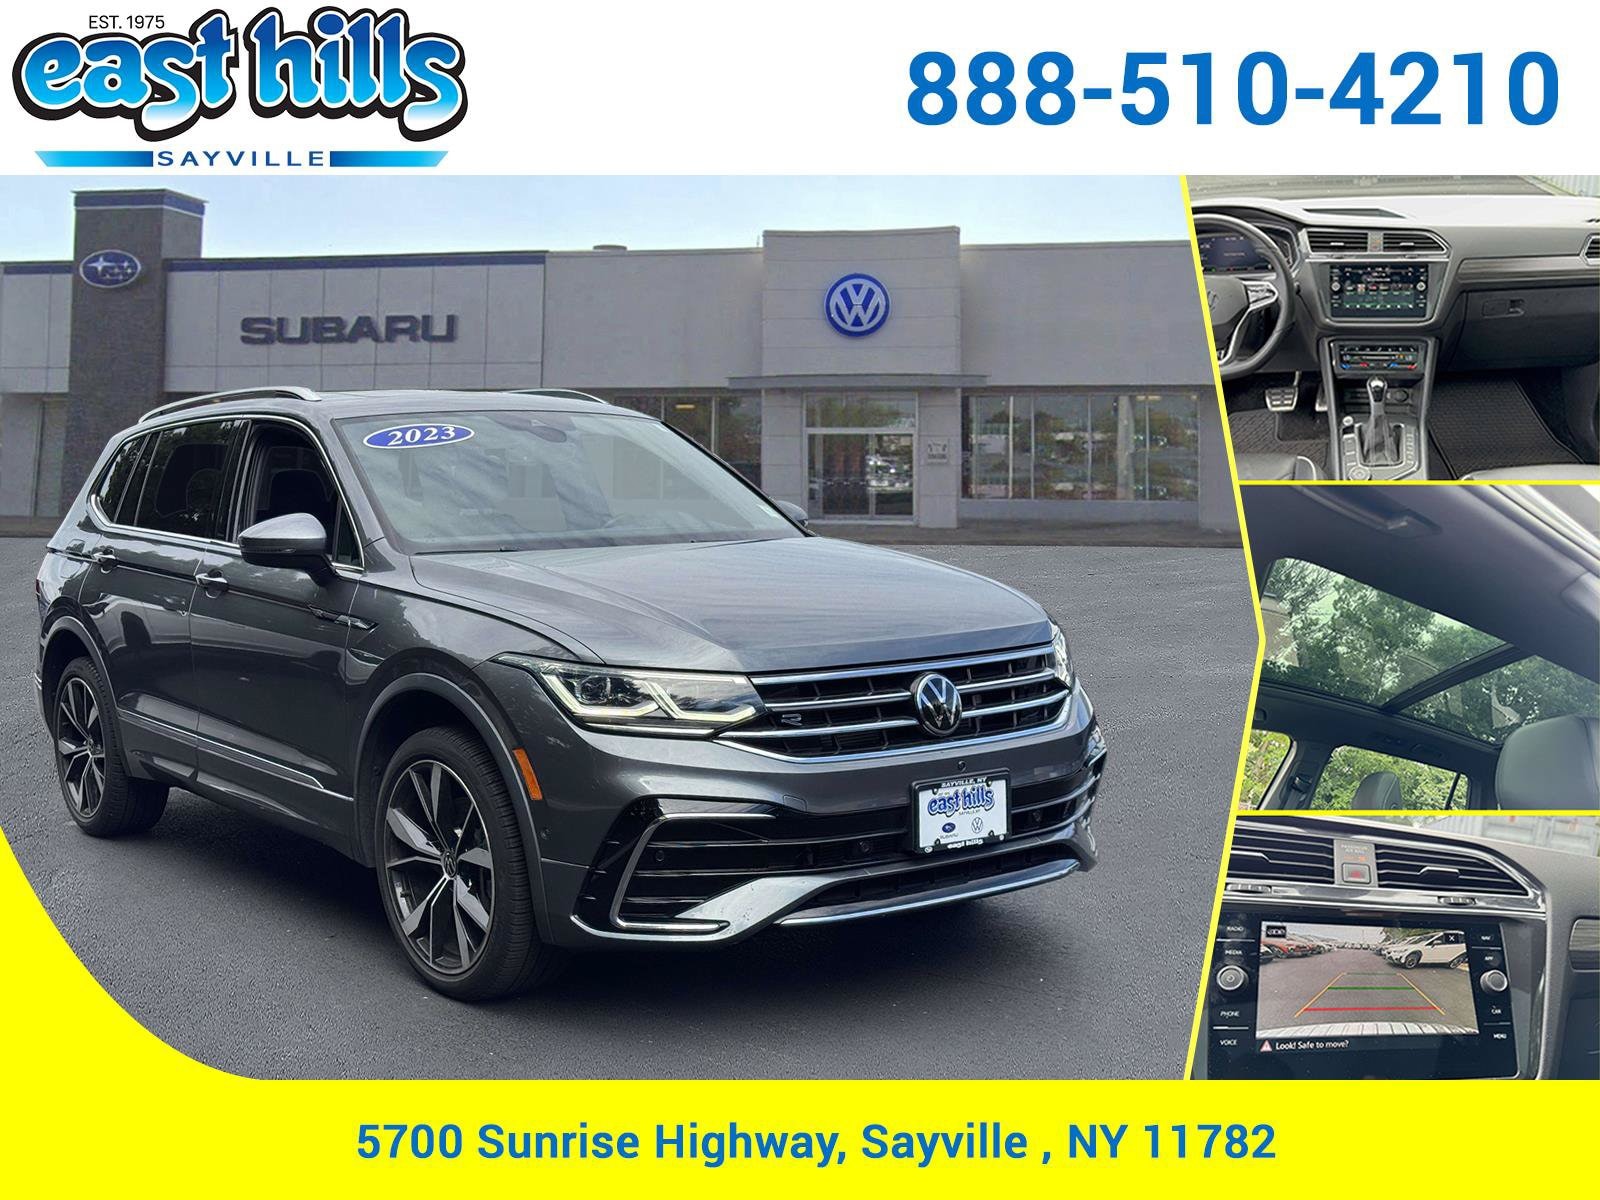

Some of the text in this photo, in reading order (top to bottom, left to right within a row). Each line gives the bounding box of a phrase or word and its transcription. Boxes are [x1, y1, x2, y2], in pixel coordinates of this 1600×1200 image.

[240, 315, 457, 344] SUBARU
[387, 426, 457, 446] 2023
[928, 784, 995, 817] east hills
[1220, 1010, 1240, 1018] PHONE
[1219, 1038, 1238, 1046] VOICE
[1275, 1041, 1296, 1050] Look!
[1297, 1041, 1315, 1050] Safe
[1325, 1040, 1349, 1048] move?
